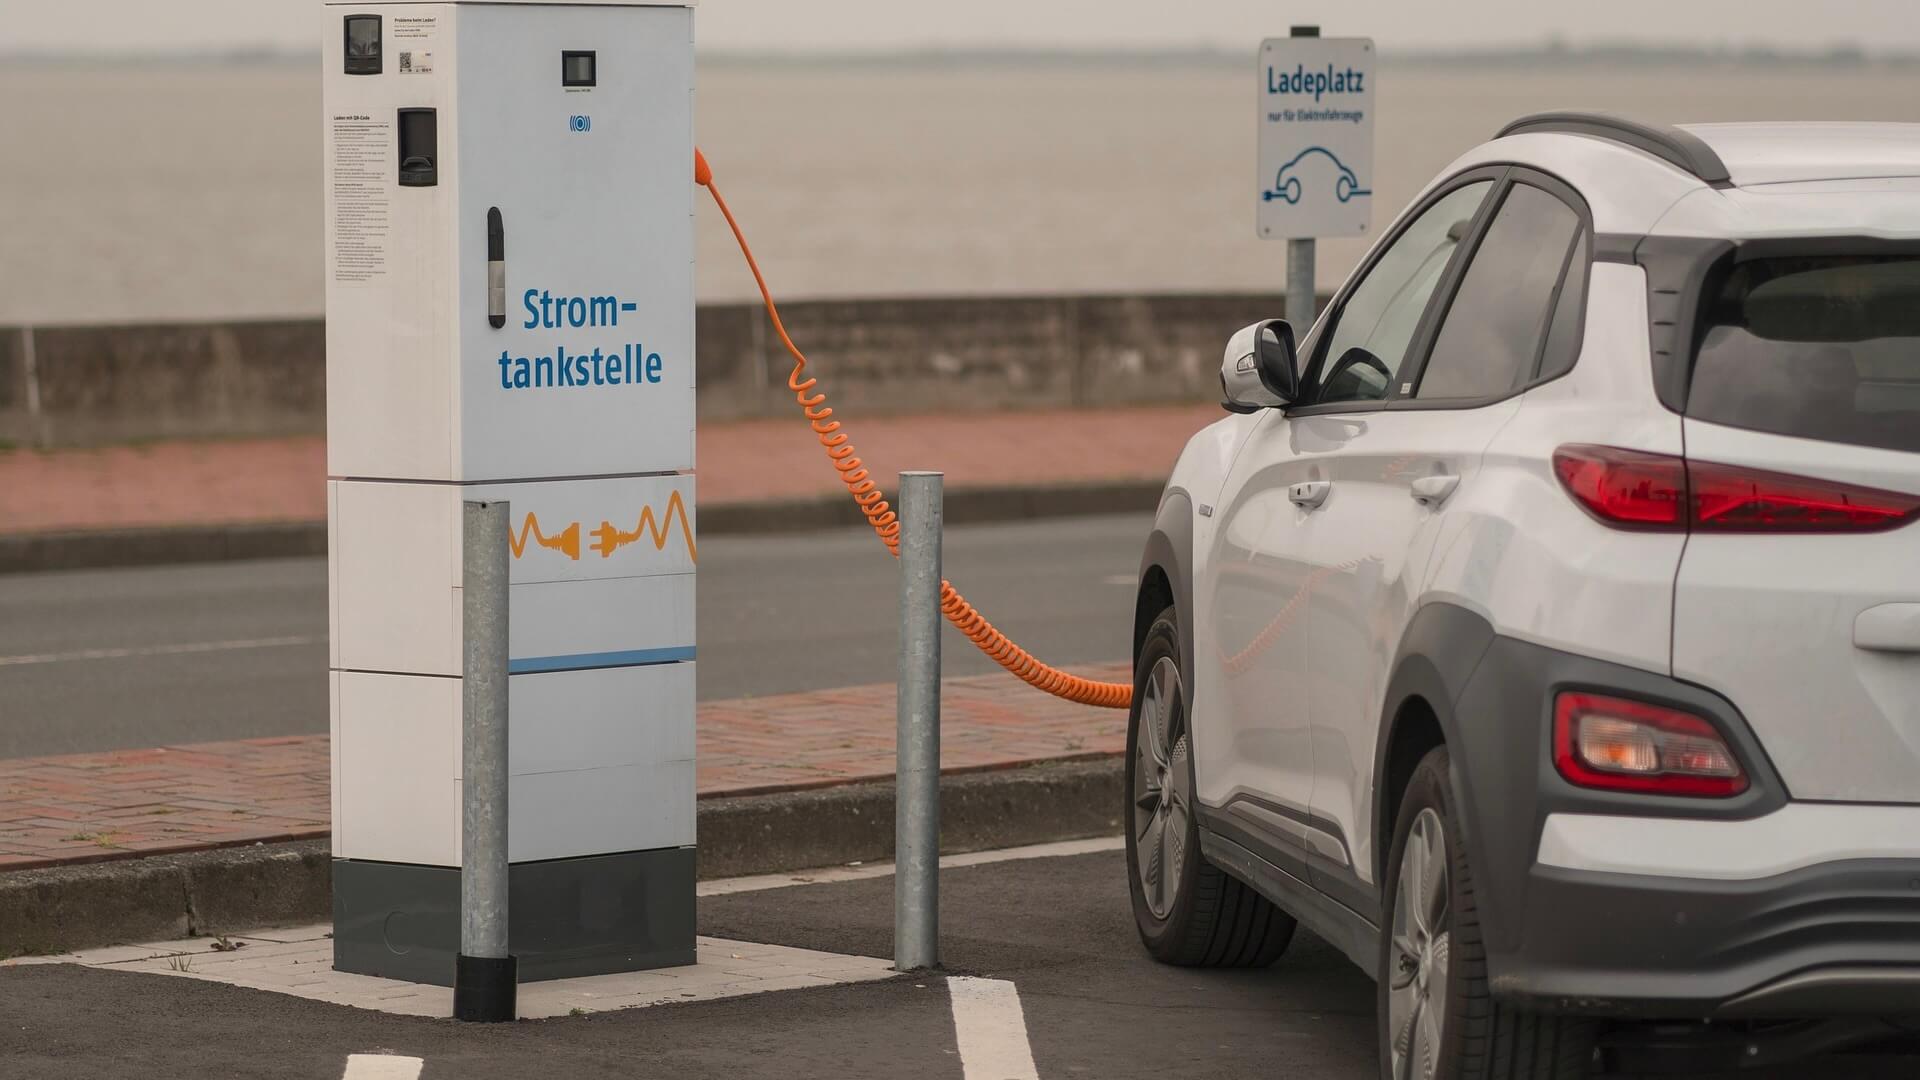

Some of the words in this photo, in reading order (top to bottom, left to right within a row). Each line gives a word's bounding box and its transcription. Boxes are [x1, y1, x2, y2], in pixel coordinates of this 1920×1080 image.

[1268, 64, 1364, 103] Ladeplatz
[1267, 112, 1281, 121] nur
[1297, 109, 1363, 124] Elektrofahrzeuge
[524, 288, 637, 330] Strom-
[498, 343, 662, 389] tankstelle
